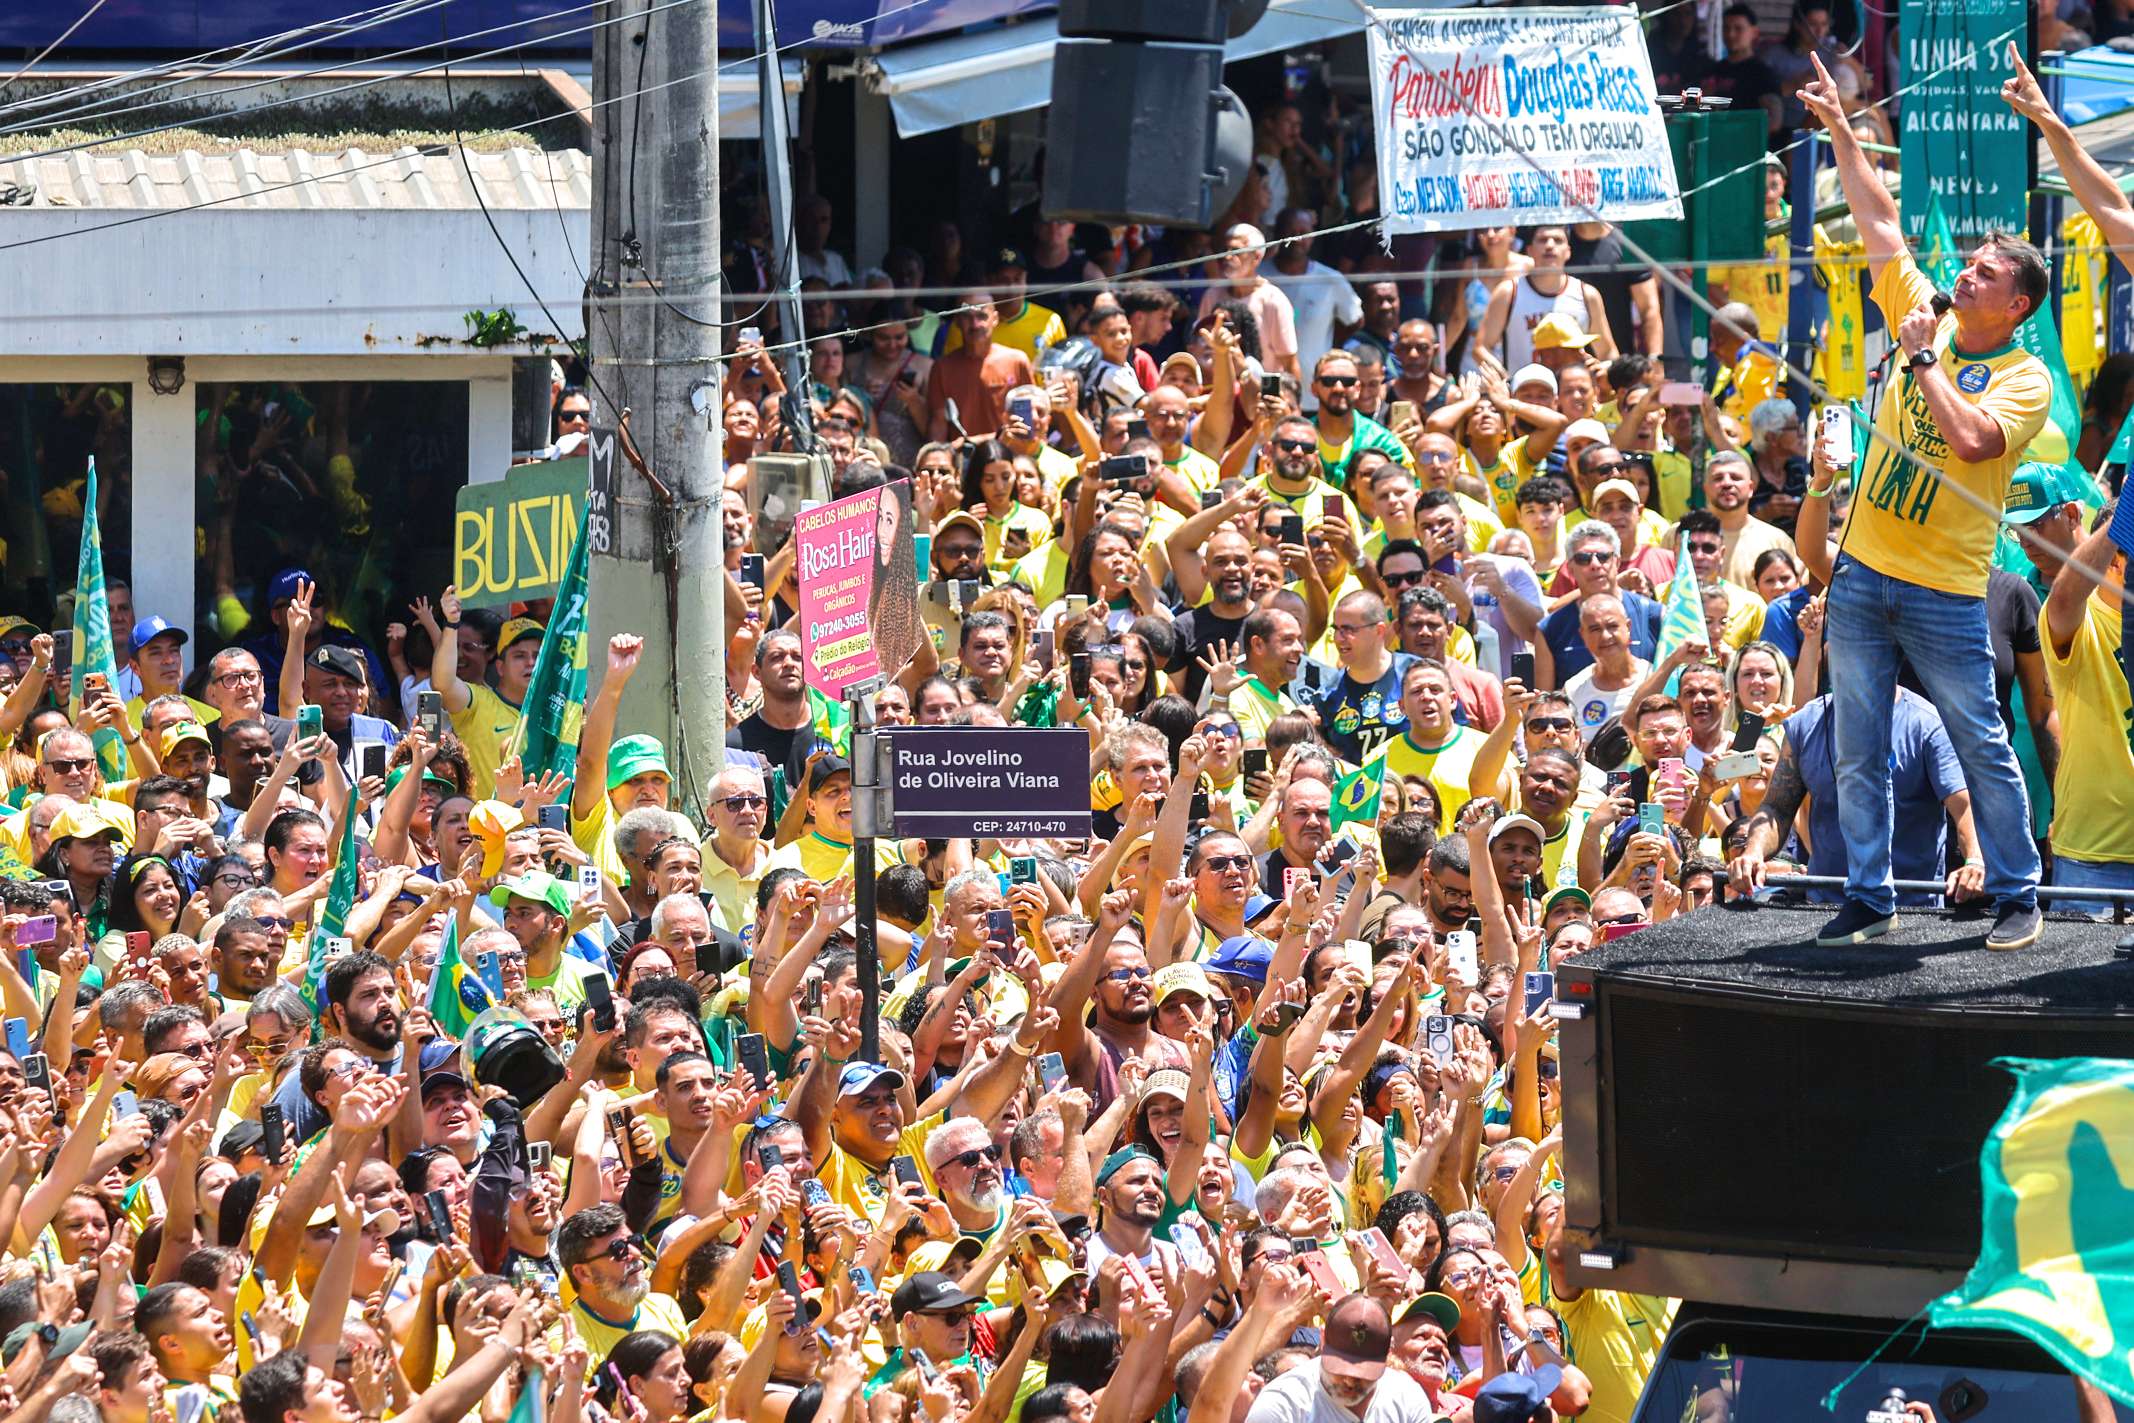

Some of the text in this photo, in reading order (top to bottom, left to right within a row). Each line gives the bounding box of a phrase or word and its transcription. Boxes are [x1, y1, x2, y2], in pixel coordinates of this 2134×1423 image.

[1910, 38, 1978, 71] LINHA
[1389, 48, 1650, 128] Parabéns Douglas Ruas
[1906, 104, 2020, 132] ALCÂNTARA
[1405, 121, 1644, 160] SÃO GONÇALO TEM ORGULHO
[799, 496, 877, 533] CABELOS HUMANOS
[838, 527, 873, 569] Hair
[812, 573, 866, 601] PERUCAS, JUMBOS E
[823, 593, 856, 613] ORGÂNICOS
[819, 610, 865, 638] 97240-3055
[820, 636, 869, 661] Prédio do Relógio
[829, 662, 856, 680] Calçadão
[898, 749, 1023, 766] Rua Jovelino
[899, 771, 1060, 788] de Oliveira Viana
[973, 821, 1067, 832] CEP: 24710-470
